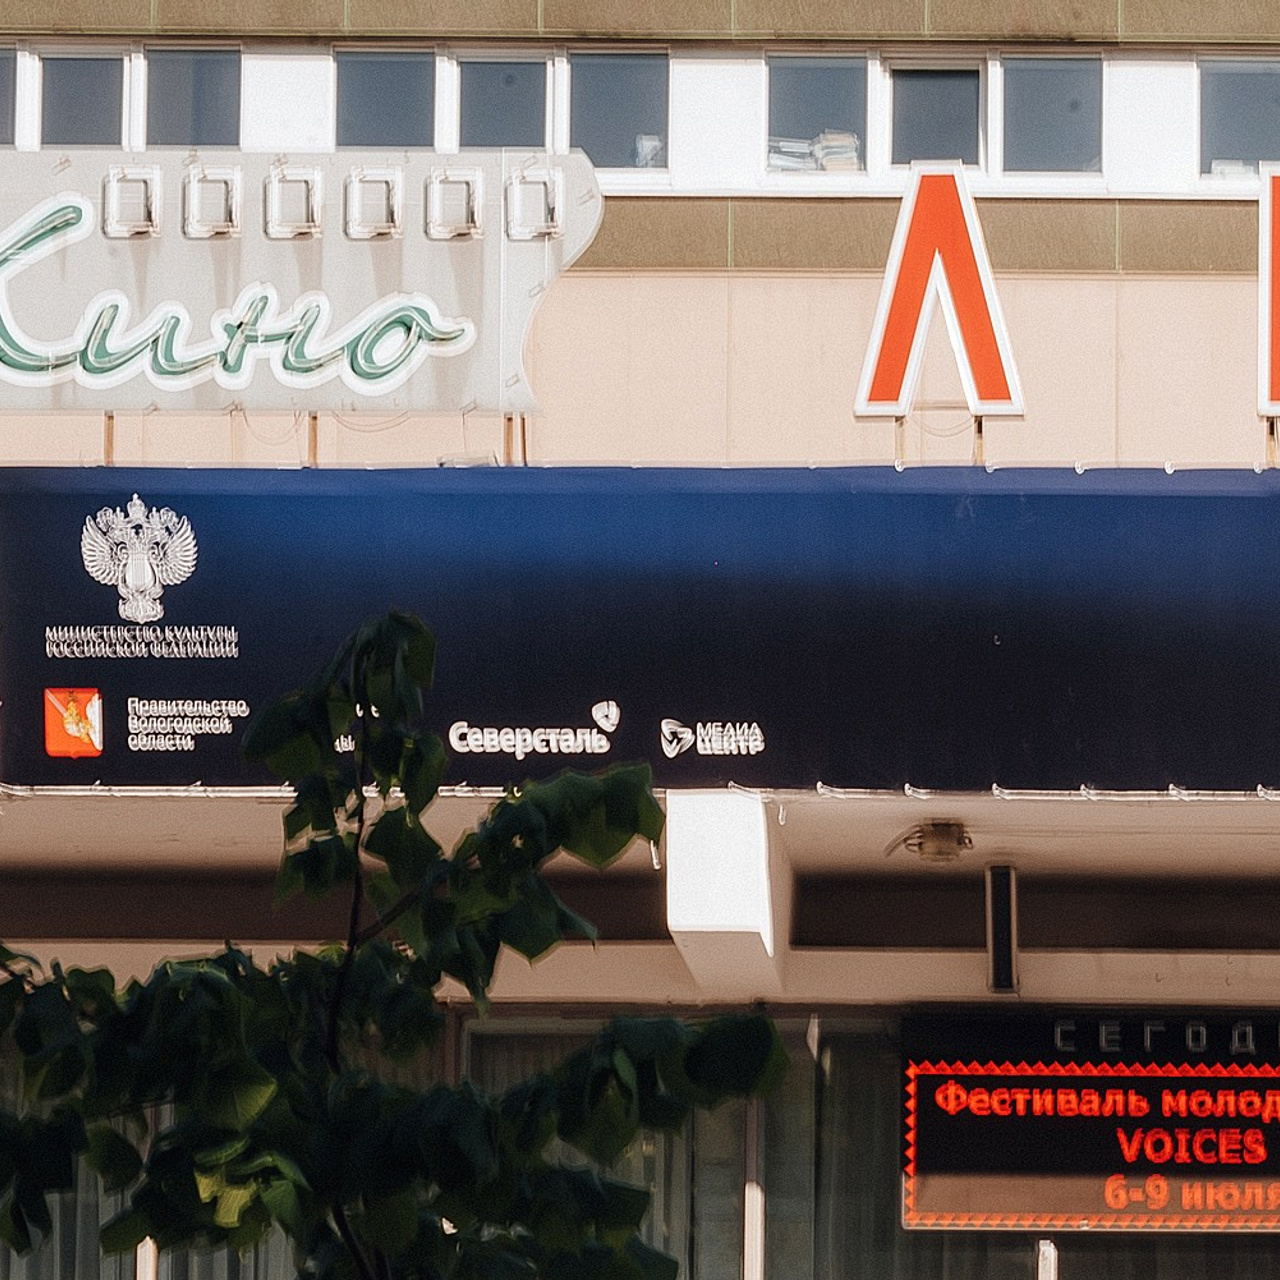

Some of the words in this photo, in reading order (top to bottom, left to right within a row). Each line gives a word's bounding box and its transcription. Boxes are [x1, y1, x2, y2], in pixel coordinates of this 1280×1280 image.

[45, 626, 164, 643] МИНИСТЕРСТВО
[165, 626, 239, 643] КУЛЬТУРЫ
[127, 698, 250, 717] Правительство
[128, 715, 233, 735] Вологодской
[128, 734, 195, 751] области
[449, 721, 611, 760] Северсталь
[935, 1080, 1150, 1118] Фестиваль
[1116, 1127, 1268, 1164] VOICES
[1104, 1174, 1169, 1210] 6-9
